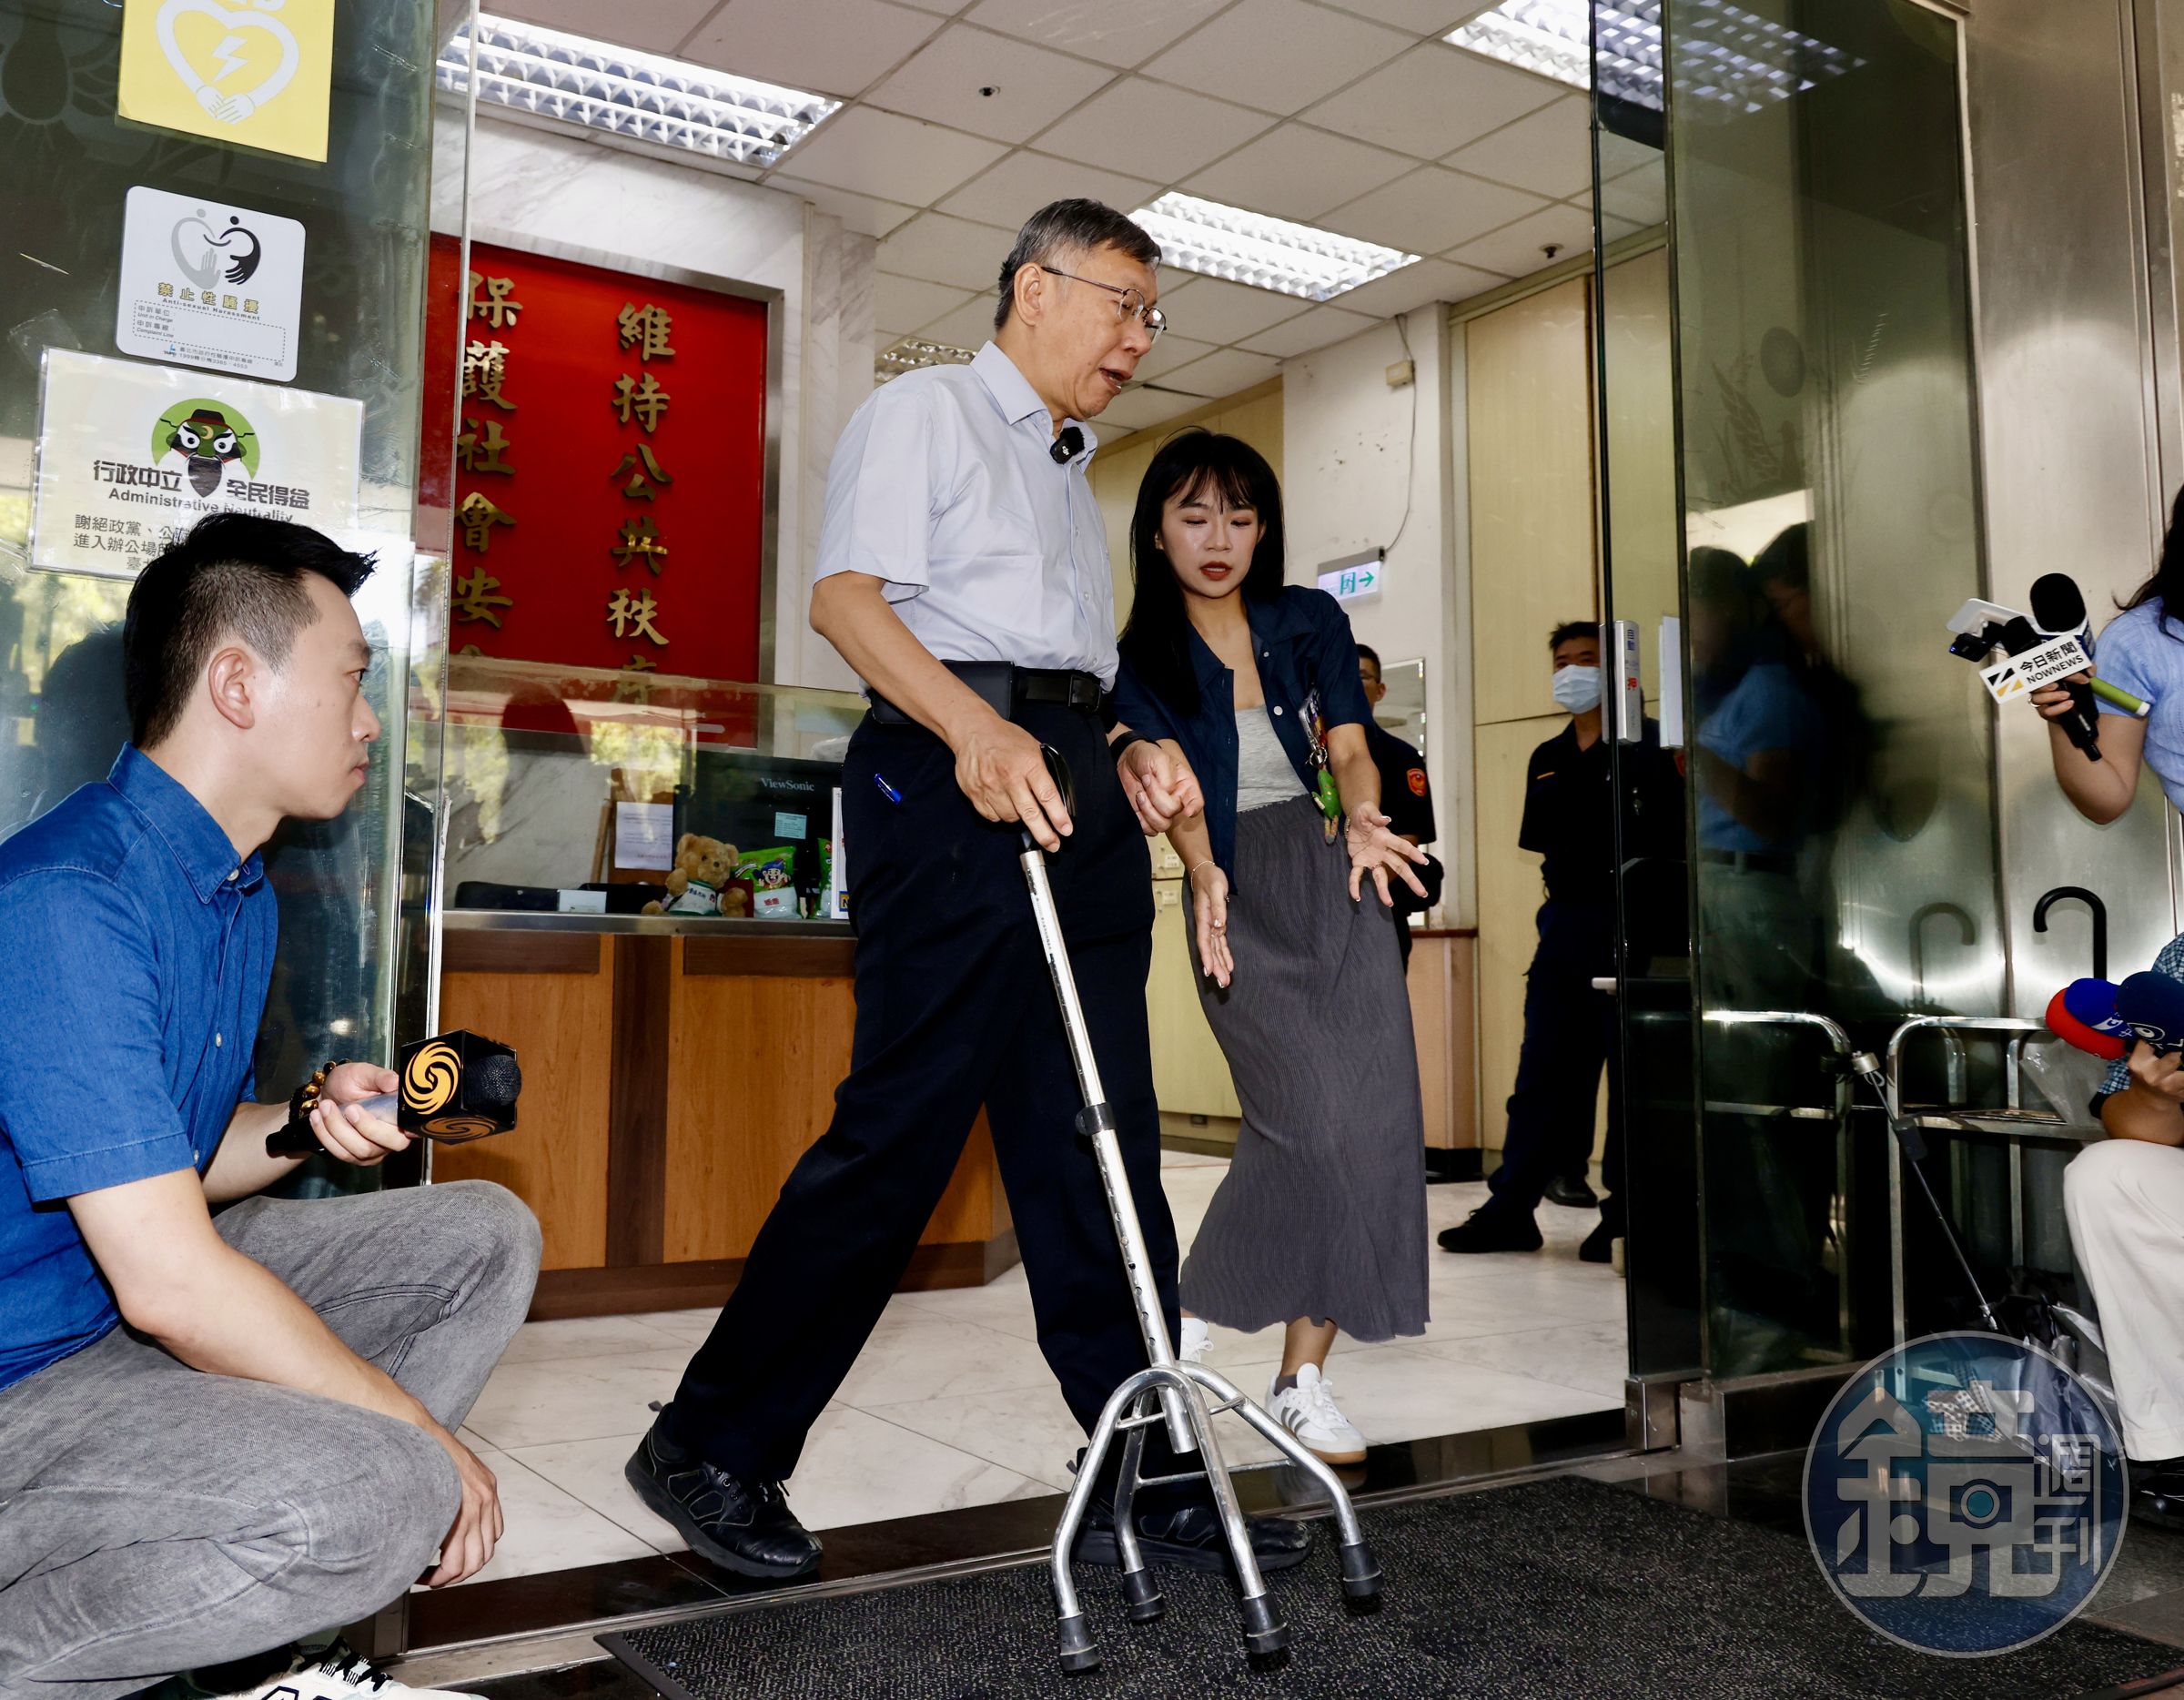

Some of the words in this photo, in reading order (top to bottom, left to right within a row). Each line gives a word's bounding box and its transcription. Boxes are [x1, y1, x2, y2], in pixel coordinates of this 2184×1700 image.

[157, 282, 259, 314] 禁止性騷擾
[163, 299, 209, 311] Anti-sexual
[447, 270, 523, 656] 保護社會安
[93, 460, 182, 492] 行政中立
[226, 479, 310, 511] 全民得益
[108, 487, 219, 513] Administrative
[2019, 641, 2078, 673] 今日新聞
[2026, 654, 2084, 684] NOWNEWS
[761, 777, 814, 792] ViewSonic
